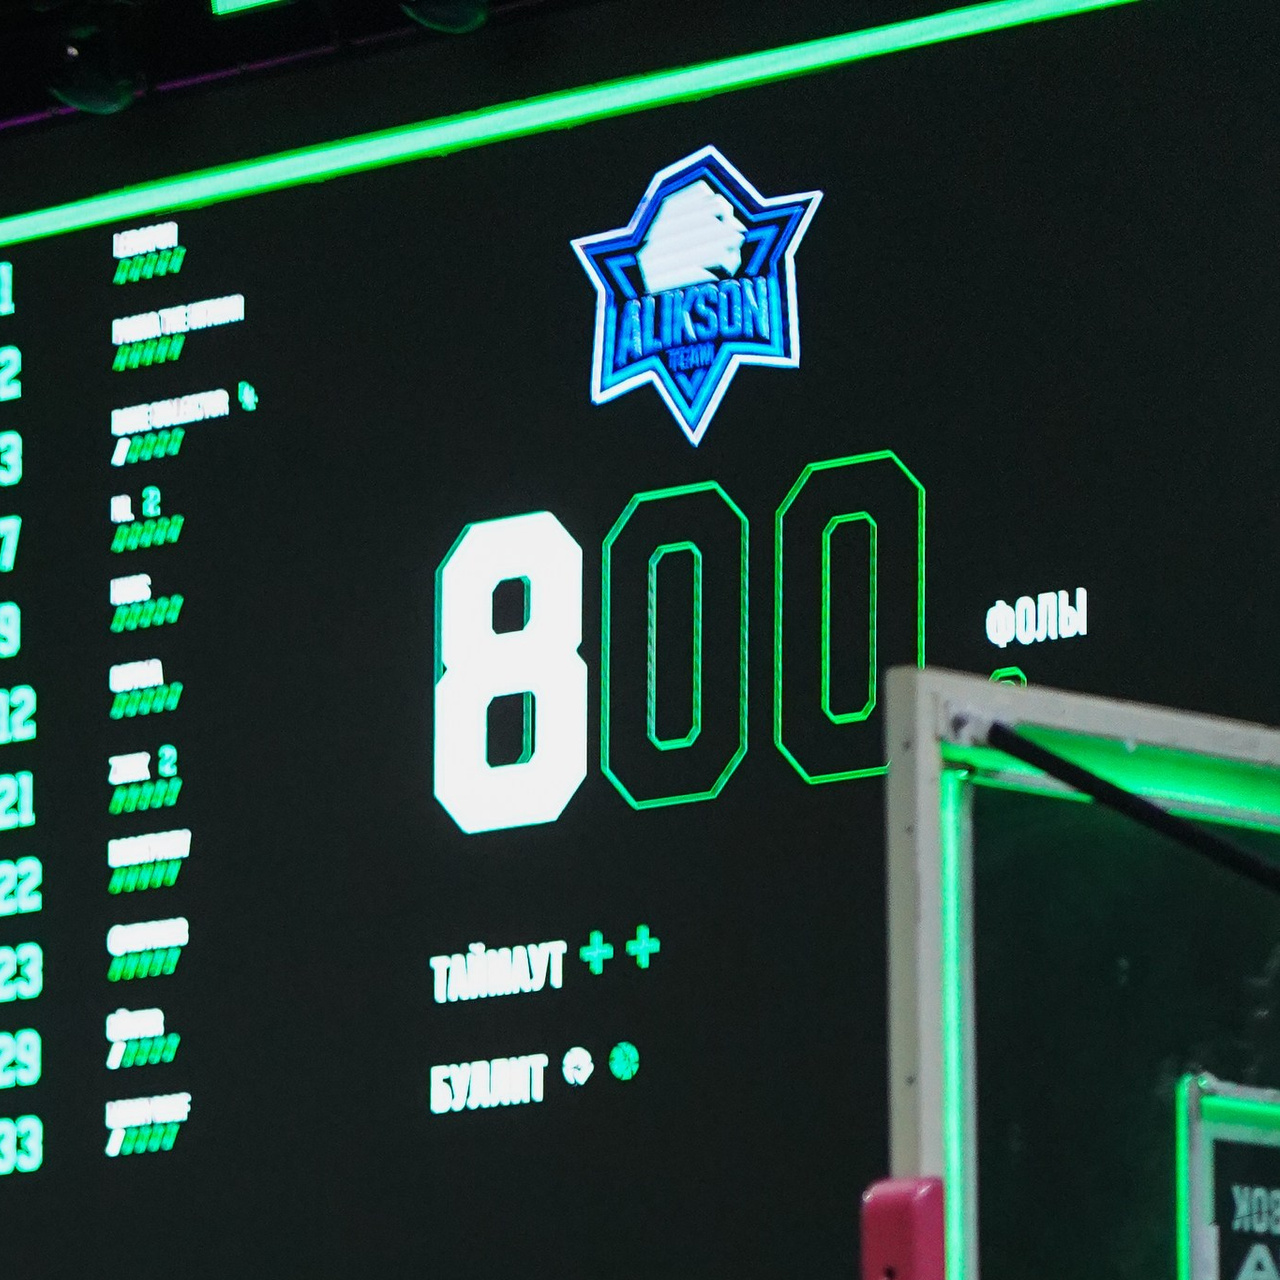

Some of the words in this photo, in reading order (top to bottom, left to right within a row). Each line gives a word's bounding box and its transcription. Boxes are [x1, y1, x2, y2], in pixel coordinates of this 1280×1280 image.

[614, 276, 770, 368] ALIKSON
[142, 486, 161, 517] 2
[986, 587, 1087, 648] ФОЛЫ
[429, 940, 568, 1003] ТАЙМАУТ
